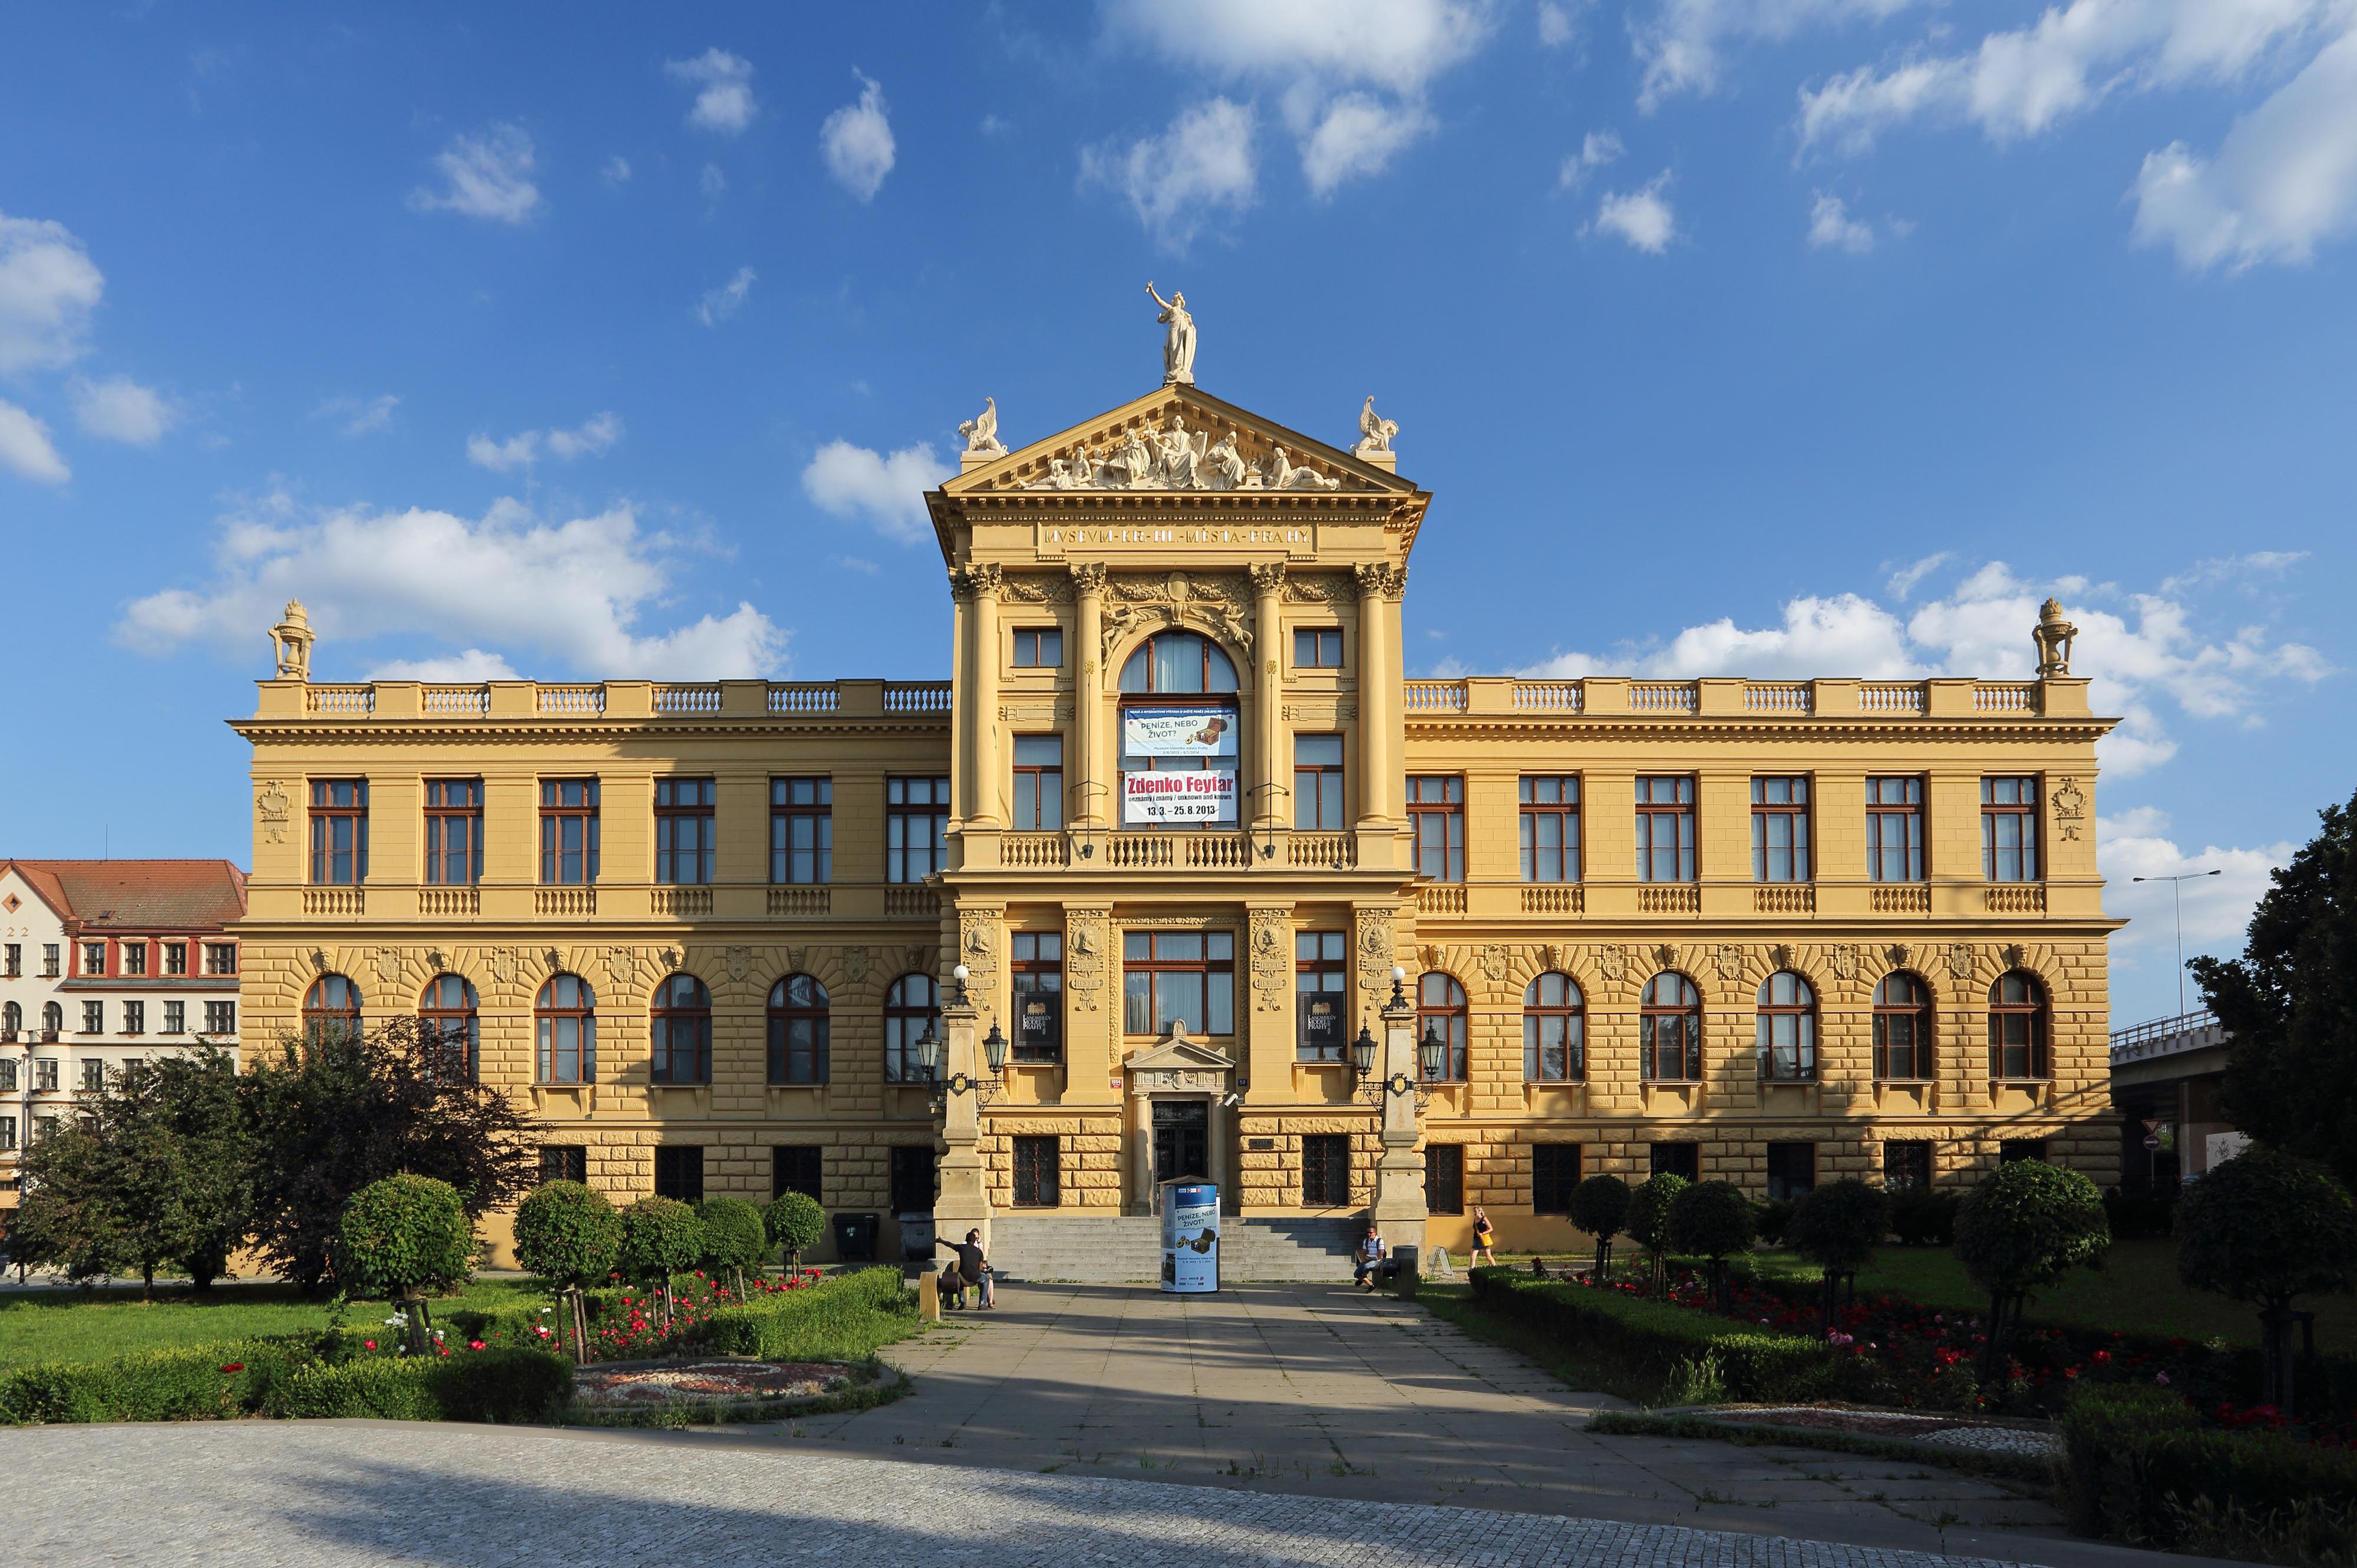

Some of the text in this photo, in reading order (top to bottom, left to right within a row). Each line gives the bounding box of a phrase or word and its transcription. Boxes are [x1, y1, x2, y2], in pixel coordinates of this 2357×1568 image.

[1141, 719, 1198, 730] PENÍZE, NEBO
[1148, 730, 1177, 738] ŽIVOT?
[1128, 776, 1233, 794] Zdenko Feyfar
[1177, 1213, 1201, 1221] PENÍZE,
[1183, 1219, 1204, 1227] ŽIVOT?
